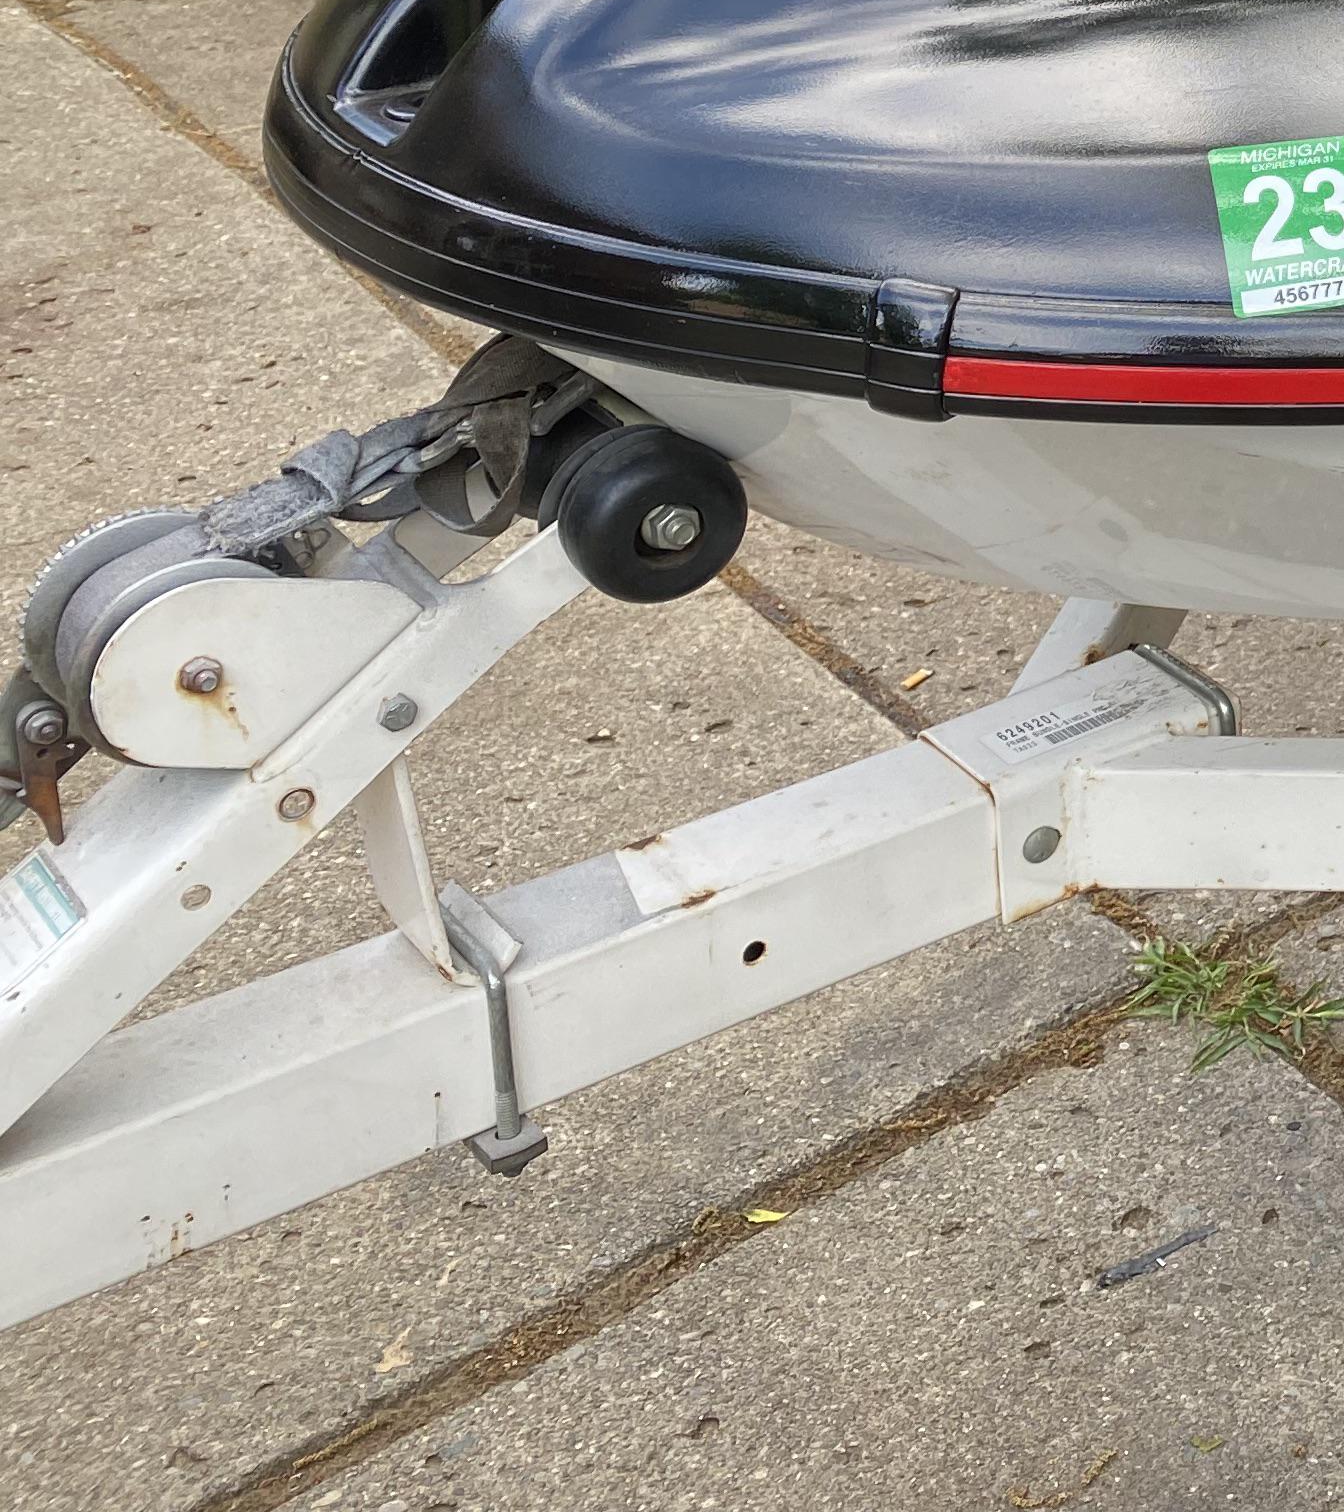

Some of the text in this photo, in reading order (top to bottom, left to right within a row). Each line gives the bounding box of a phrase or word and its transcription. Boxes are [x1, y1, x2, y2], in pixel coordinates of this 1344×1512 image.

[1240, 140, 1340, 164] MICHIGAN
[1251, 156, 1334, 173] EXPIRES MAR 31
[996, 711, 1061, 741] 6249201
